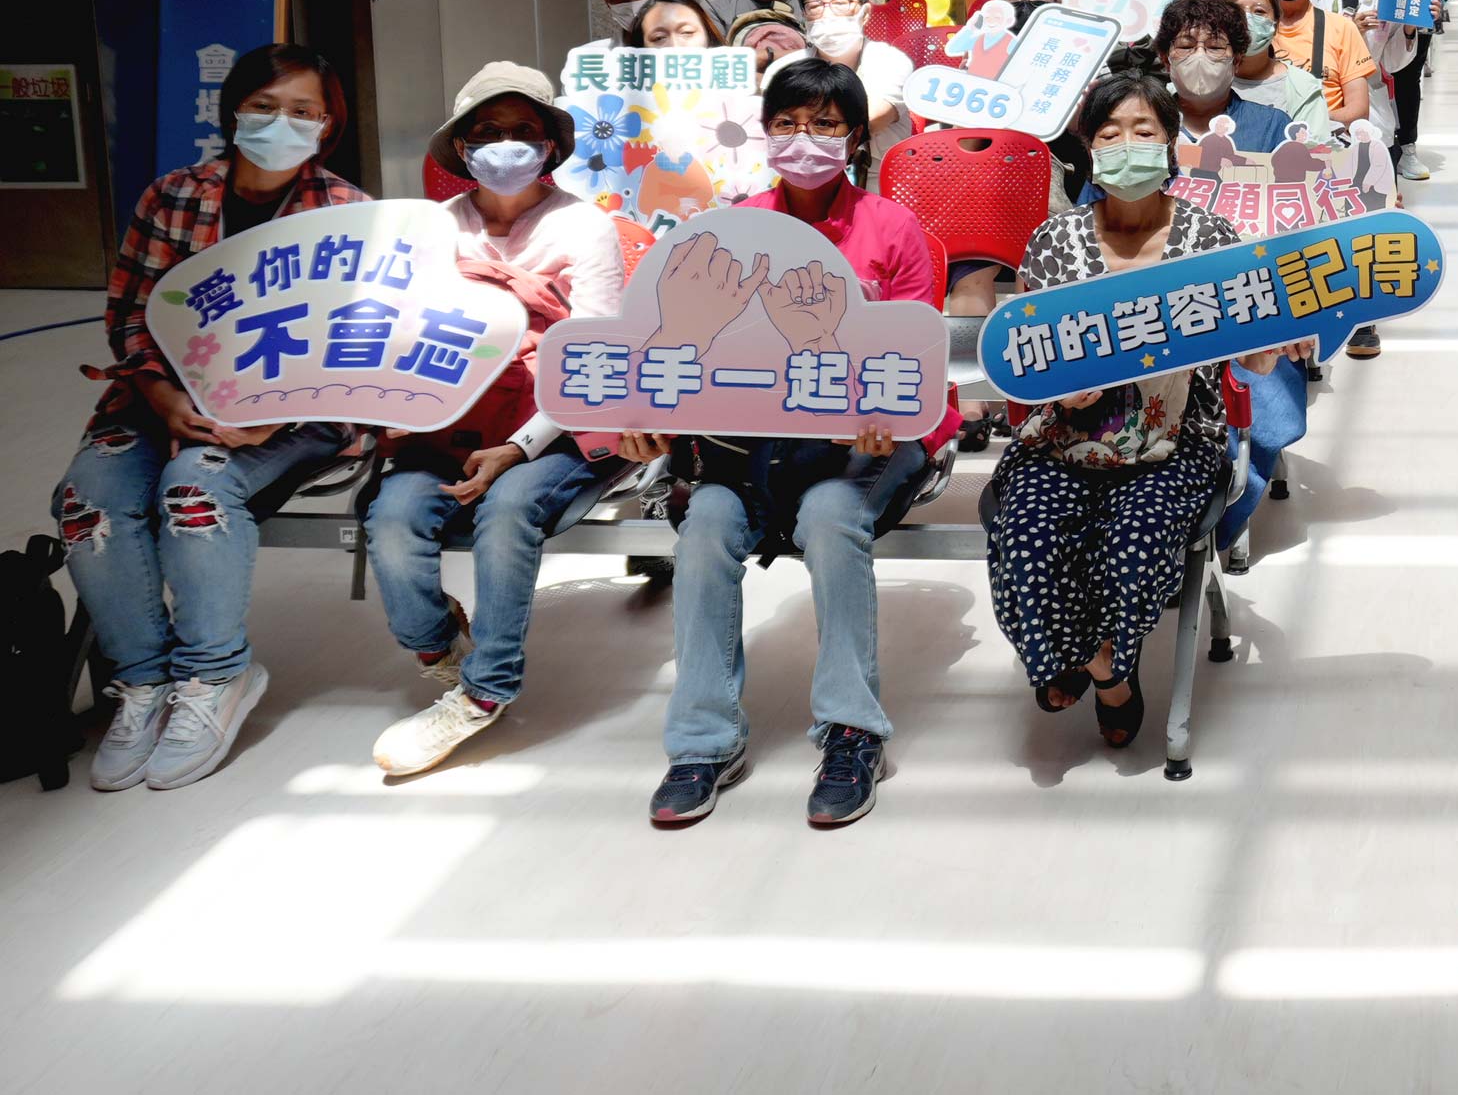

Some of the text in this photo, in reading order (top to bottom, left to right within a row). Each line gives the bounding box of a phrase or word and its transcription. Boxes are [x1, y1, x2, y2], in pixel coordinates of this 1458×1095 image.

[570, 53, 749, 92] 長期照顧
[1031, 37, 1061, 69] 長照
[1031, 52, 1081, 115] 服務專線
[920, 77, 1010, 119] 1966
[1164, 176, 1367, 236] 照顧同行
[184, 233, 415, 329] 愛你的心
[1001, 232, 1420, 378] 你的笑容我記得
[233, 298, 488, 386] 不會忘
[560, 341, 923, 416] 牽手一起走
